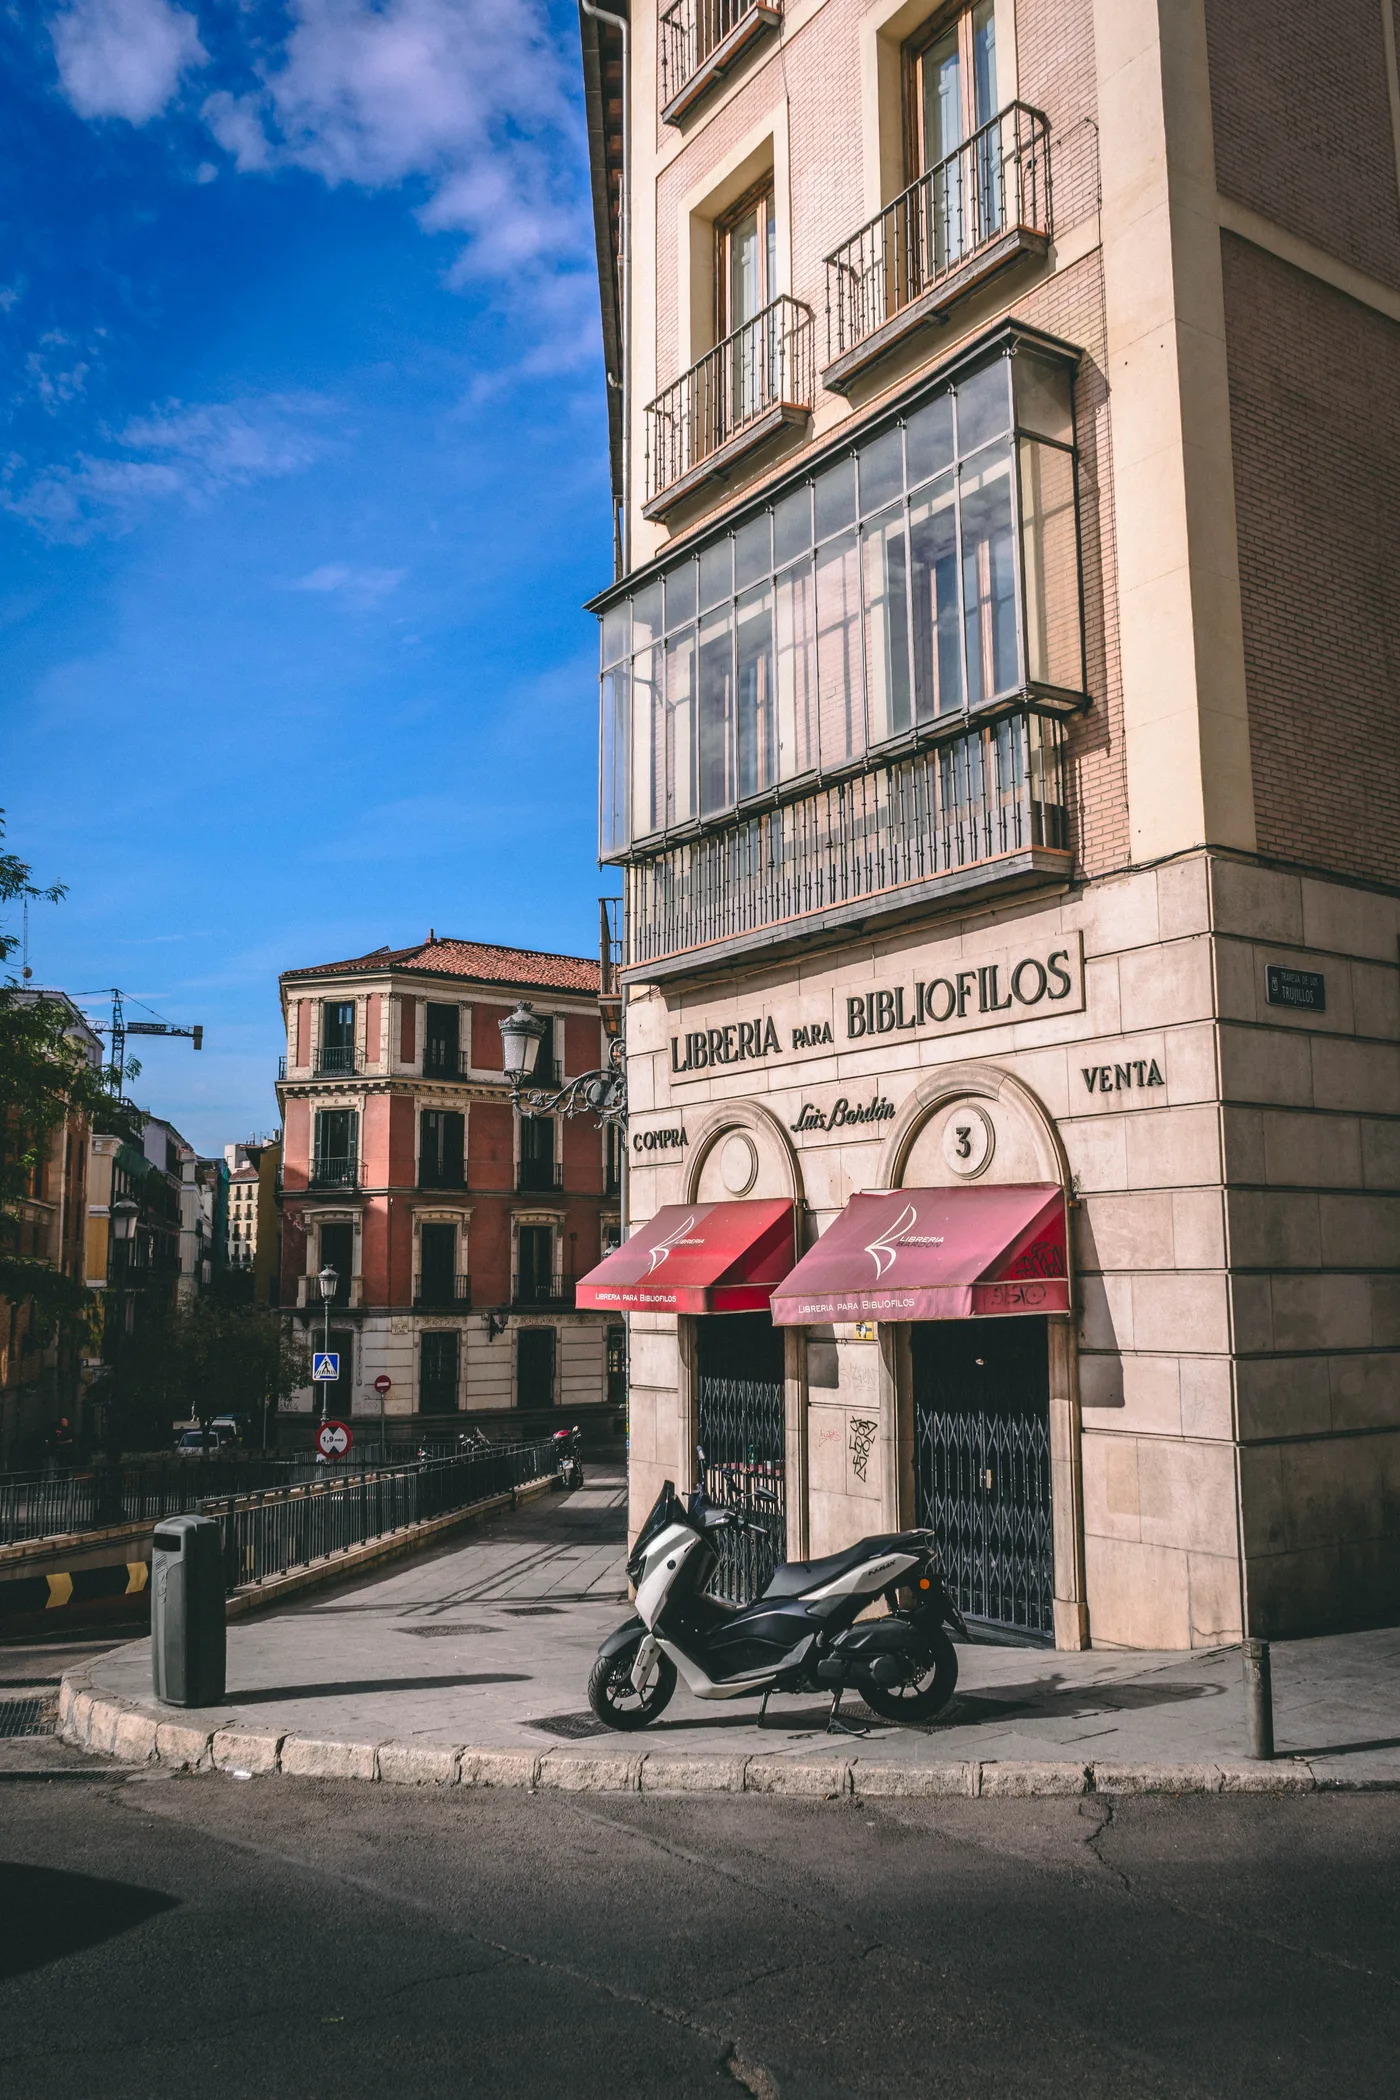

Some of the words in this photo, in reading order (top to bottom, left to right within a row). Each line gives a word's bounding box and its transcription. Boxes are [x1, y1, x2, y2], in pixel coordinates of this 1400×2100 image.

[1282, 985, 1314, 1004] TRUJILLOS
[671, 1015, 783, 1073] LIBRERIA
[792, 1021, 834, 1049] PARA
[846, 950, 1071, 1039] BIBLIOFILOS
[1080, 1059, 1165, 1093] VENTA
[790, 1103, 827, 1132] Luis
[633, 1126, 689, 1152] COMPRA
[955, 1126, 972, 1159] 3
[595, 1292, 620, 1301] LIBRERIA
[622, 1294, 638, 1302] PARA
[639, 1294, 677, 1303] BIBLIOFILOS
[798, 1304, 834, 1314] LIBRERIA
[837, 1302, 859, 1311] PARA
[862, 1298, 915, 1310] BIBLIOFILOS
